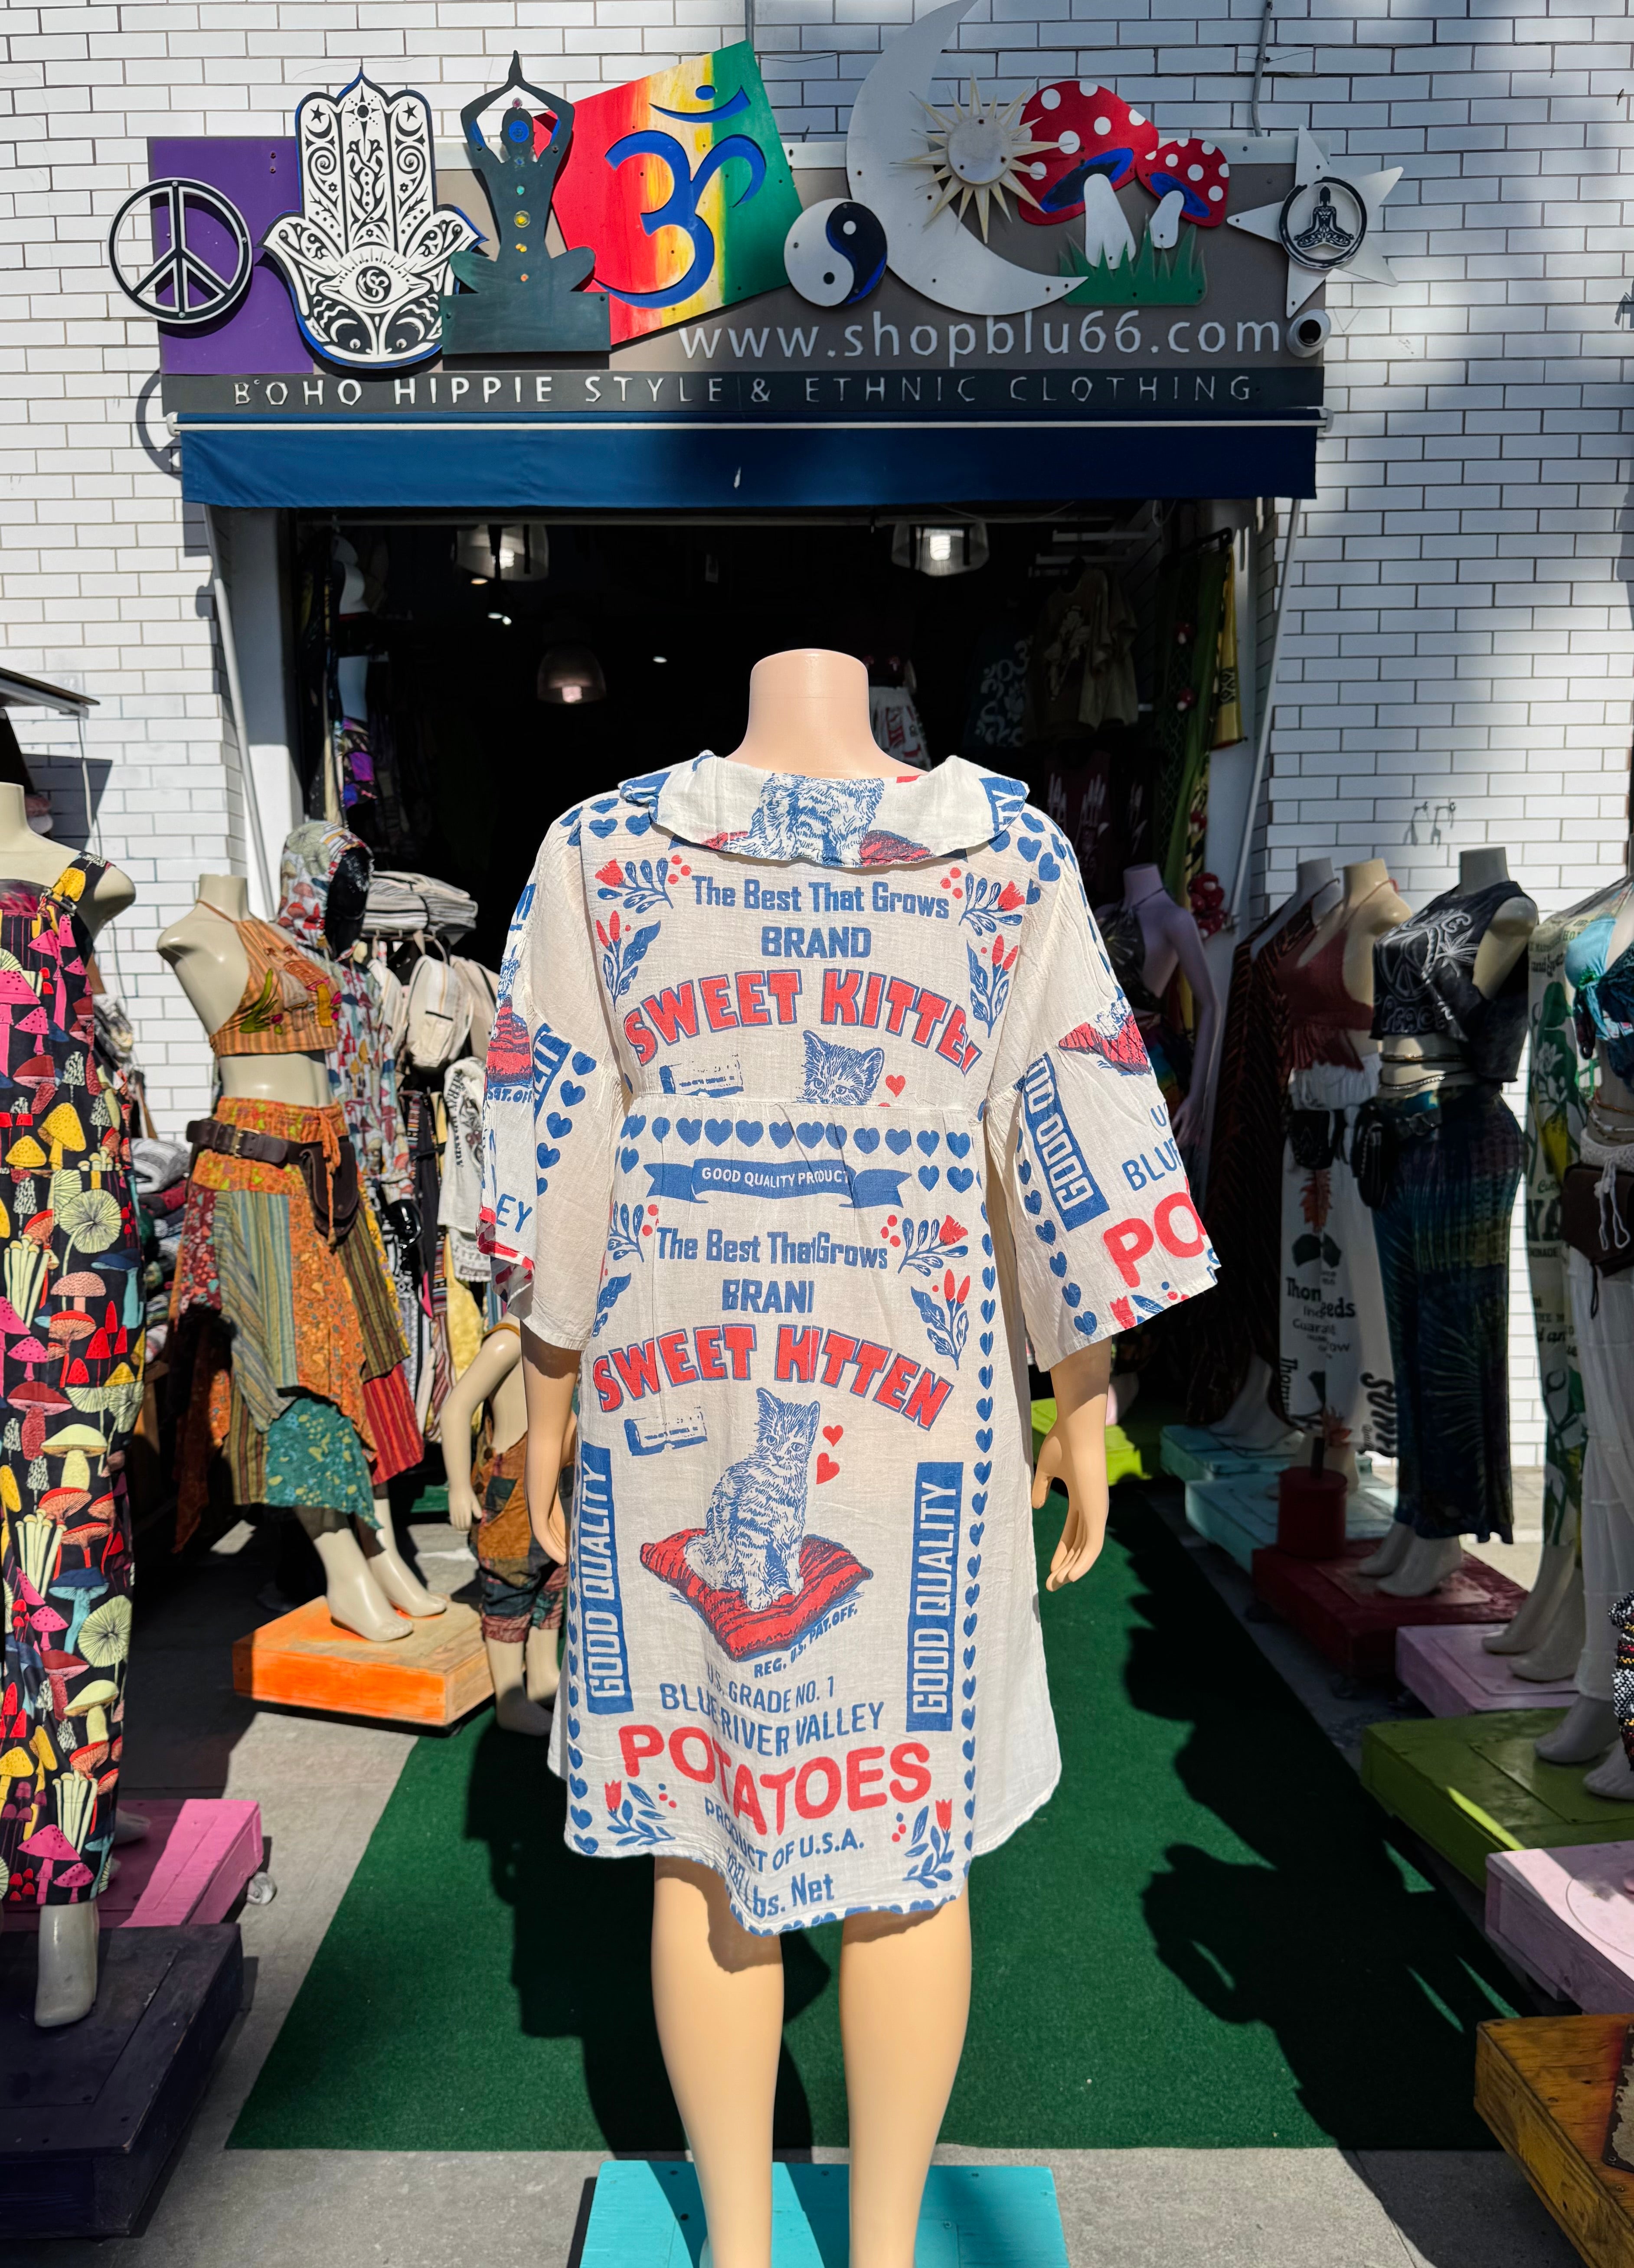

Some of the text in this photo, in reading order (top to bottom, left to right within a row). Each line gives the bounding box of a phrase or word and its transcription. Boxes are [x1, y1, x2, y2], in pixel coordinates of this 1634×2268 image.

[679, 310, 1280, 368] www.shopblu66.com
[234, 375, 1252, 408] BOHO HIPPIE STYLE & ETHNIC CLOTHING
[692, 875, 949, 918] The Best That Grows
[761, 926, 872, 959] BRAND
[624, 968, 802, 1066] SWEET
[702, 1167, 741, 1183] GOOD
[744, 1172, 795, 1188] QUALITY
[1036, 1113, 1094, 1211] GOOD
[657, 1227, 698, 1260] The
[706, 1228, 761, 1263] Best
[816, 1231, 888, 1269] Grows
[593, 1323, 757, 1412] SWEET
[581, 1460, 625, 1699] GOOD QUALITY
[912, 1481, 957, 1715] GOOD QUALITY
[754, 1658, 787, 1678] REG.
[791, 1644, 806, 1663] U.S.
[660, 1683, 884, 1756] BLUE RIVER VALLEY
[729, 1681, 792, 1713] GRADE
[796, 1680, 820, 1707] NO.
[827, 1675, 834, 1697] 1
[618, 1724, 931, 1836] POTATOES
[704, 1796, 865, 1873] PRODUCT OF U.S.A.
[791, 1872, 835, 1907] Net
